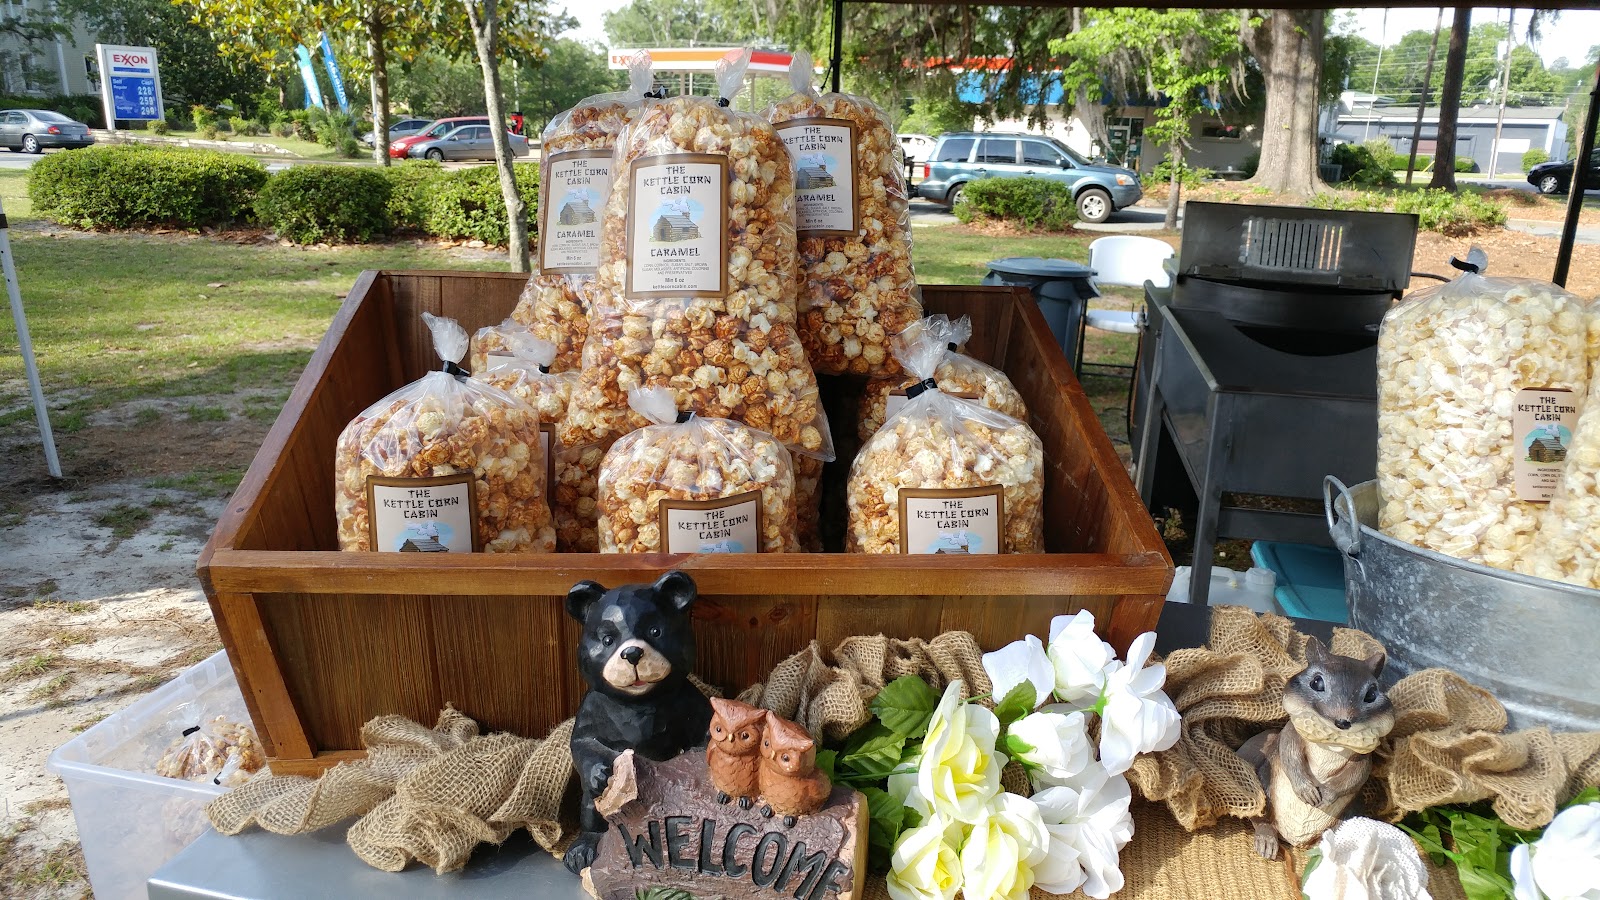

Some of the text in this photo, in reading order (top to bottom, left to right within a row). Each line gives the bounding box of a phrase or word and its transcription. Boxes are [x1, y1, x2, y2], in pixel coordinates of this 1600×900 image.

[113, 54, 148, 67] EXXON
[783, 136, 816, 145] KETTLE
[556, 169, 582, 178] KETTLE
[666, 166, 686, 174] THE
[567, 177, 590, 185] CABIN
[644, 176, 712, 187] KETTLE CORN
[660, 186, 690, 194] CABIN
[795, 194, 836, 202] ARAMEL
[556, 230, 596, 238] CARAMEL
[650, 248, 700, 257] CARAMEL
[1540, 396, 1556, 404] THE
[1518, 404, 1576, 413] KETTLE CORN
[408, 489, 430, 498] THE
[384, 496, 459, 508] KETTLE CORN
[942, 500, 963, 508] THE
[404, 510, 438, 518] CABIN
[704, 510, 724, 520] THE
[917, 508, 989, 518] KETTLE CORN
[678, 514, 748, 530] KETTLE CORN
[937, 520, 969, 528] CABIN
[699, 529, 731, 540] CABIN
[617, 815, 849, 900] WELCOME
